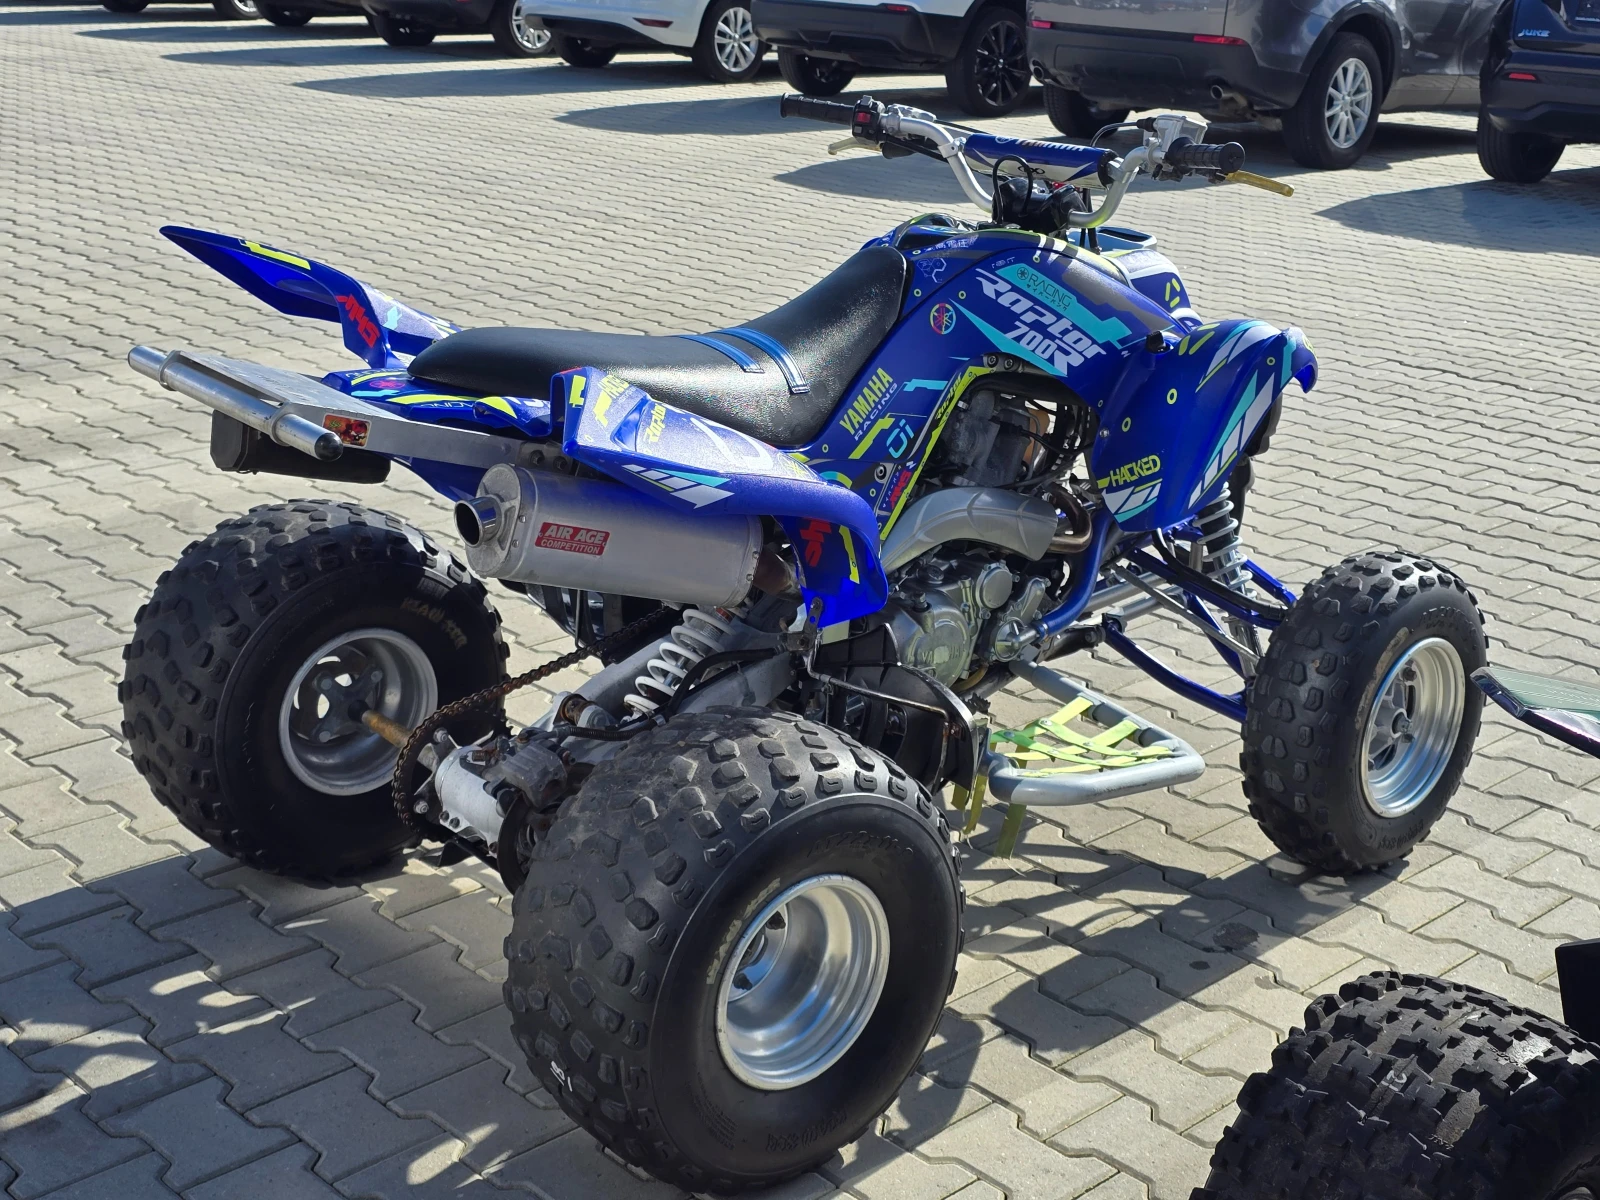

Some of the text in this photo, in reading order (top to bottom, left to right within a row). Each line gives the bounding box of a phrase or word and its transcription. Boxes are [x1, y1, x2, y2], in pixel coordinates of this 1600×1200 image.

[1028, 271, 1074, 308] RACING
[1005, 320, 1087, 376] 700R
[839, 367, 894, 435] YAMAHA
[854, 382, 898, 442] RACING
[1109, 454, 1161, 487] HACKED
[540, 538, 600, 554] COMPETITION
[544, 525, 606, 545] AIR AGE
